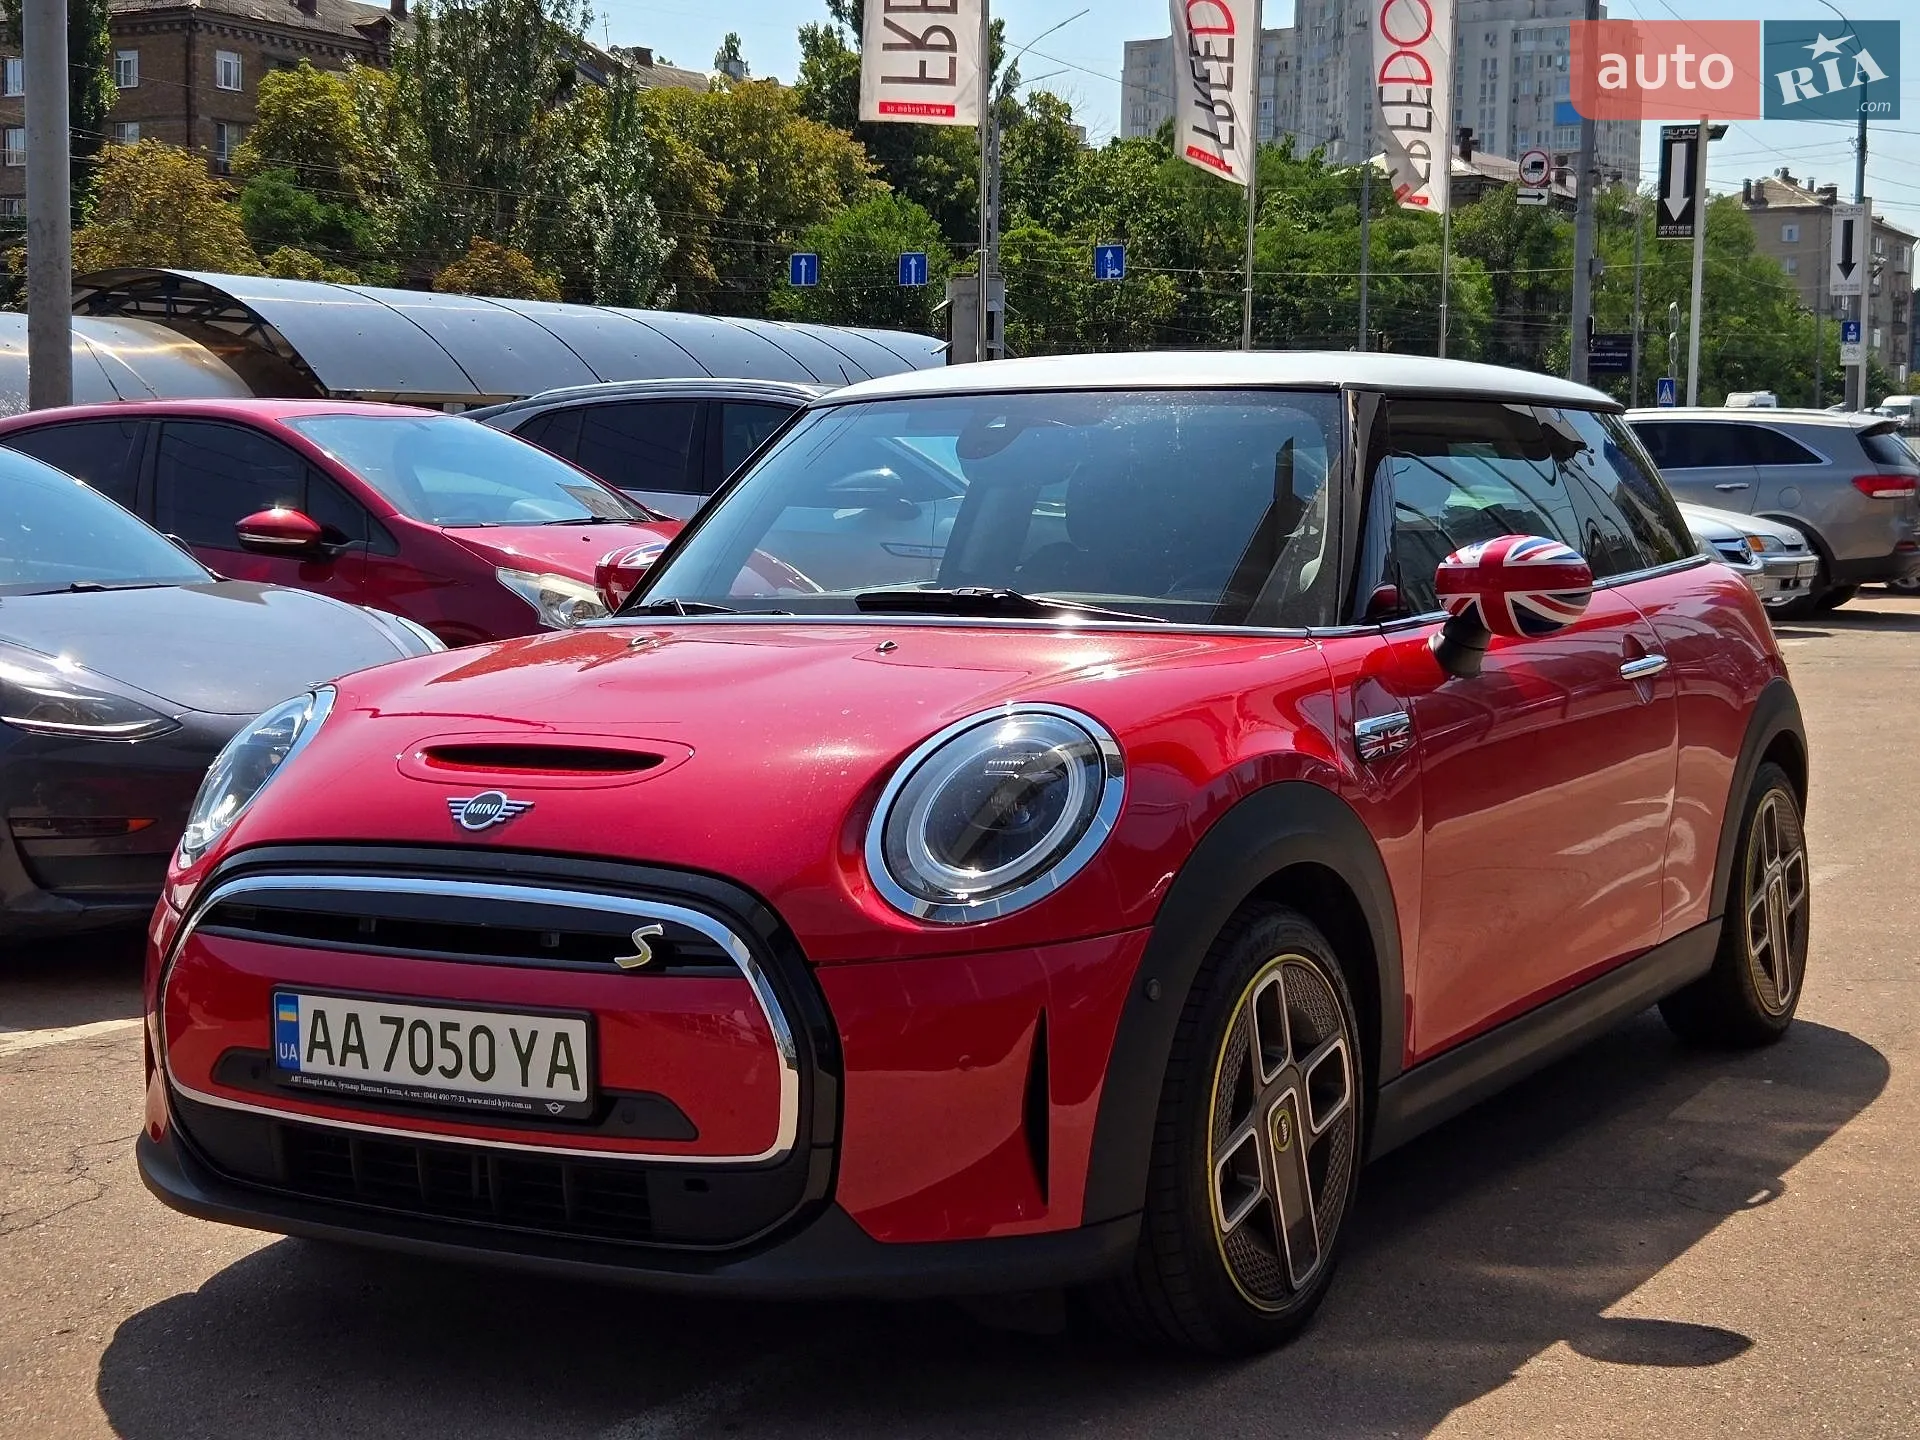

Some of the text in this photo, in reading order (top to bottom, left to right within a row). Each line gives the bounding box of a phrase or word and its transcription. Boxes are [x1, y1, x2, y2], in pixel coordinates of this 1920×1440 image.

[467, 803, 501, 815] MINI
[614, 923, 664, 969] S
[280, 1042, 298, 1061] UA
[306, 1009, 580, 1091] AA 7050 YA
